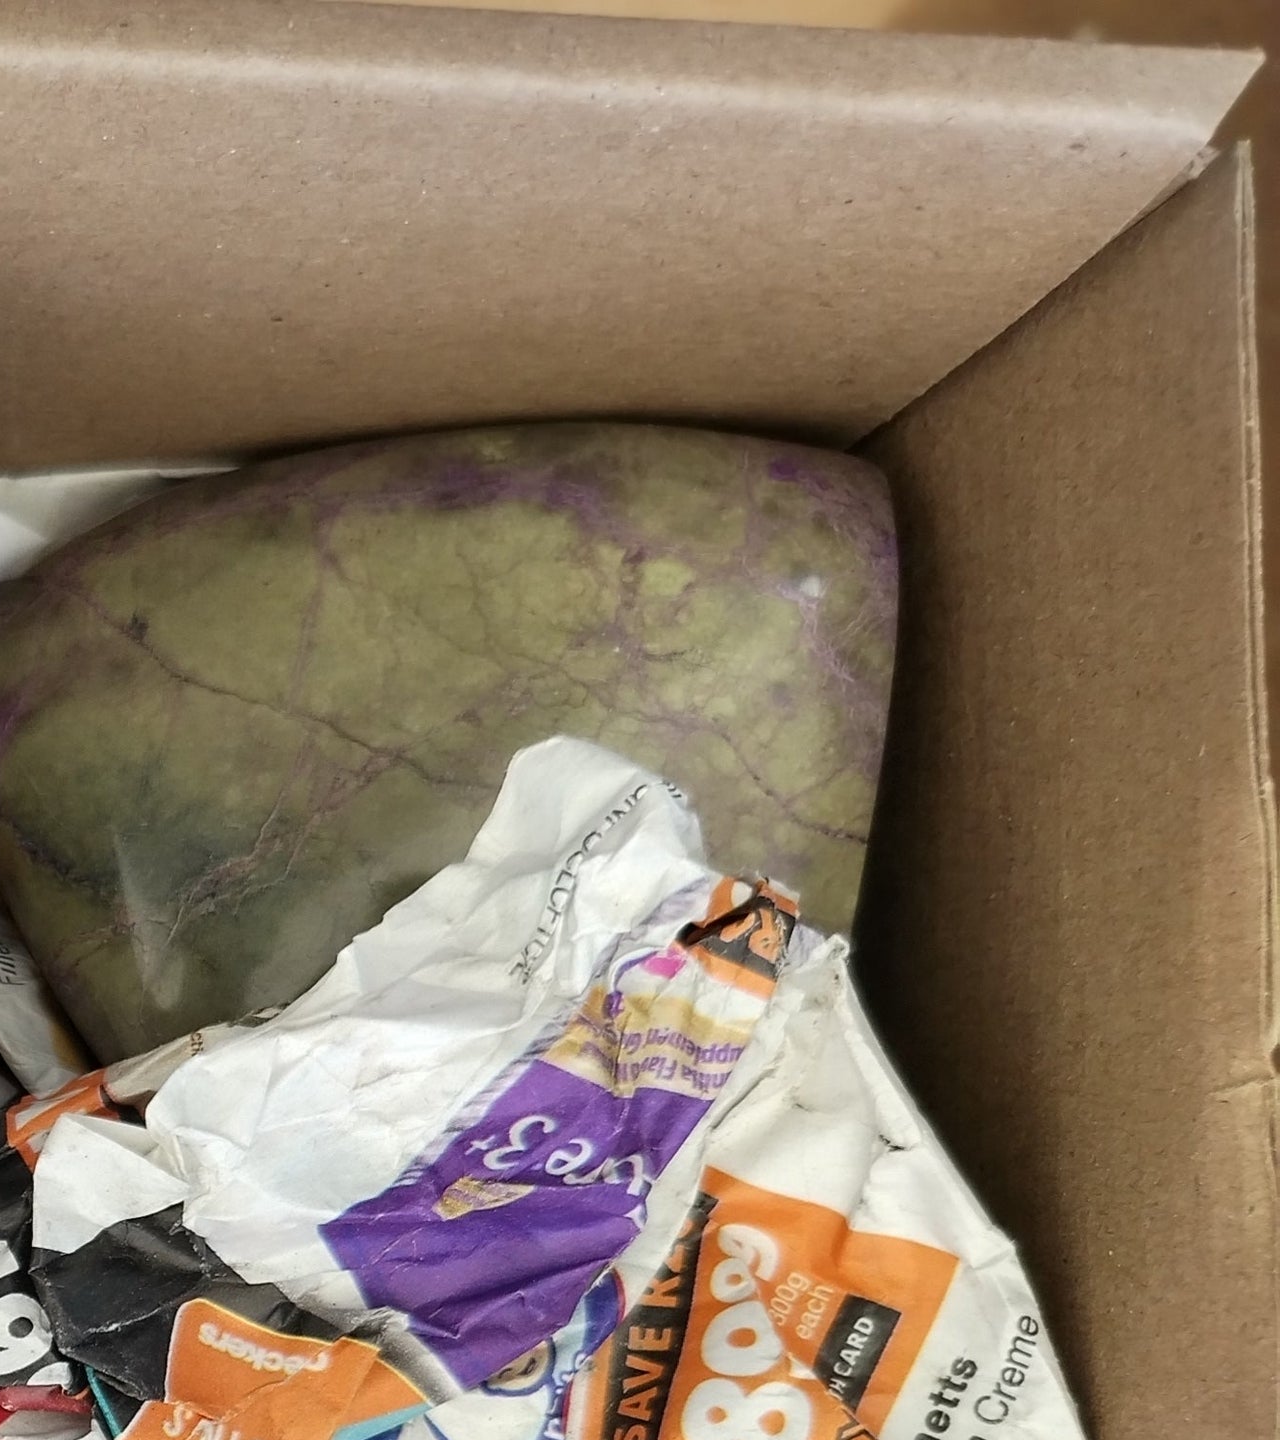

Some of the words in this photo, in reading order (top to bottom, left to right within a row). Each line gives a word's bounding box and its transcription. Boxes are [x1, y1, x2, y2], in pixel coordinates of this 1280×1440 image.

[795, 1284, 833, 1341] each
[843, 1317, 874, 1379] CARD
[975, 1313, 1040, 1425] Creme
